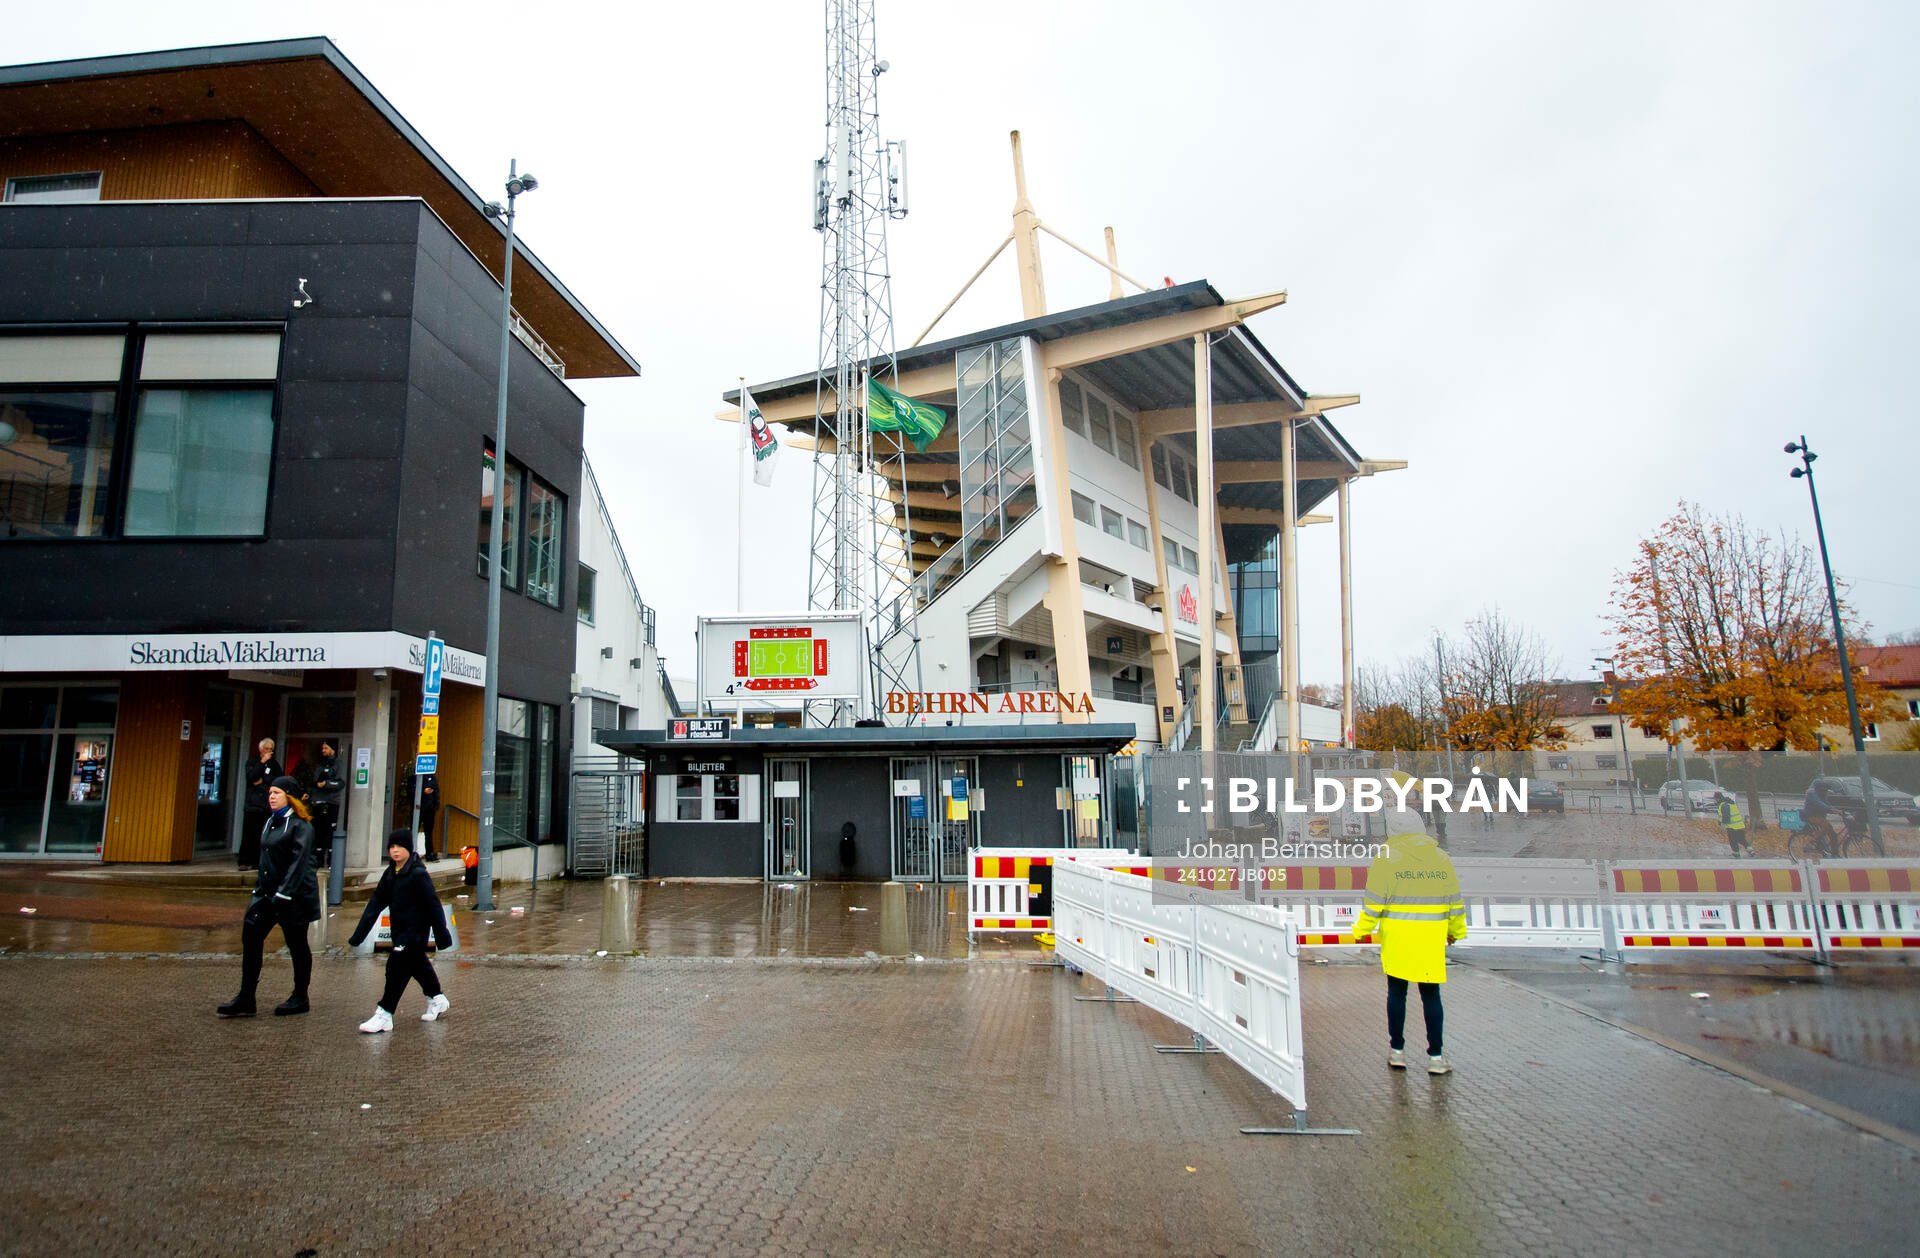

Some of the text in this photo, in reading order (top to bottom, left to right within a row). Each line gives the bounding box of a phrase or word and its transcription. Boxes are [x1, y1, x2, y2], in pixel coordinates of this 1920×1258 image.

[130, 641, 326, 664] SkandiaMäklarna
[409, 642, 482, 681] SkaMäklarna
[726, 684, 735, 695] 4
[886, 691, 1096, 714] BEHRN ARENA
[690, 720, 723, 731] BILJETT
